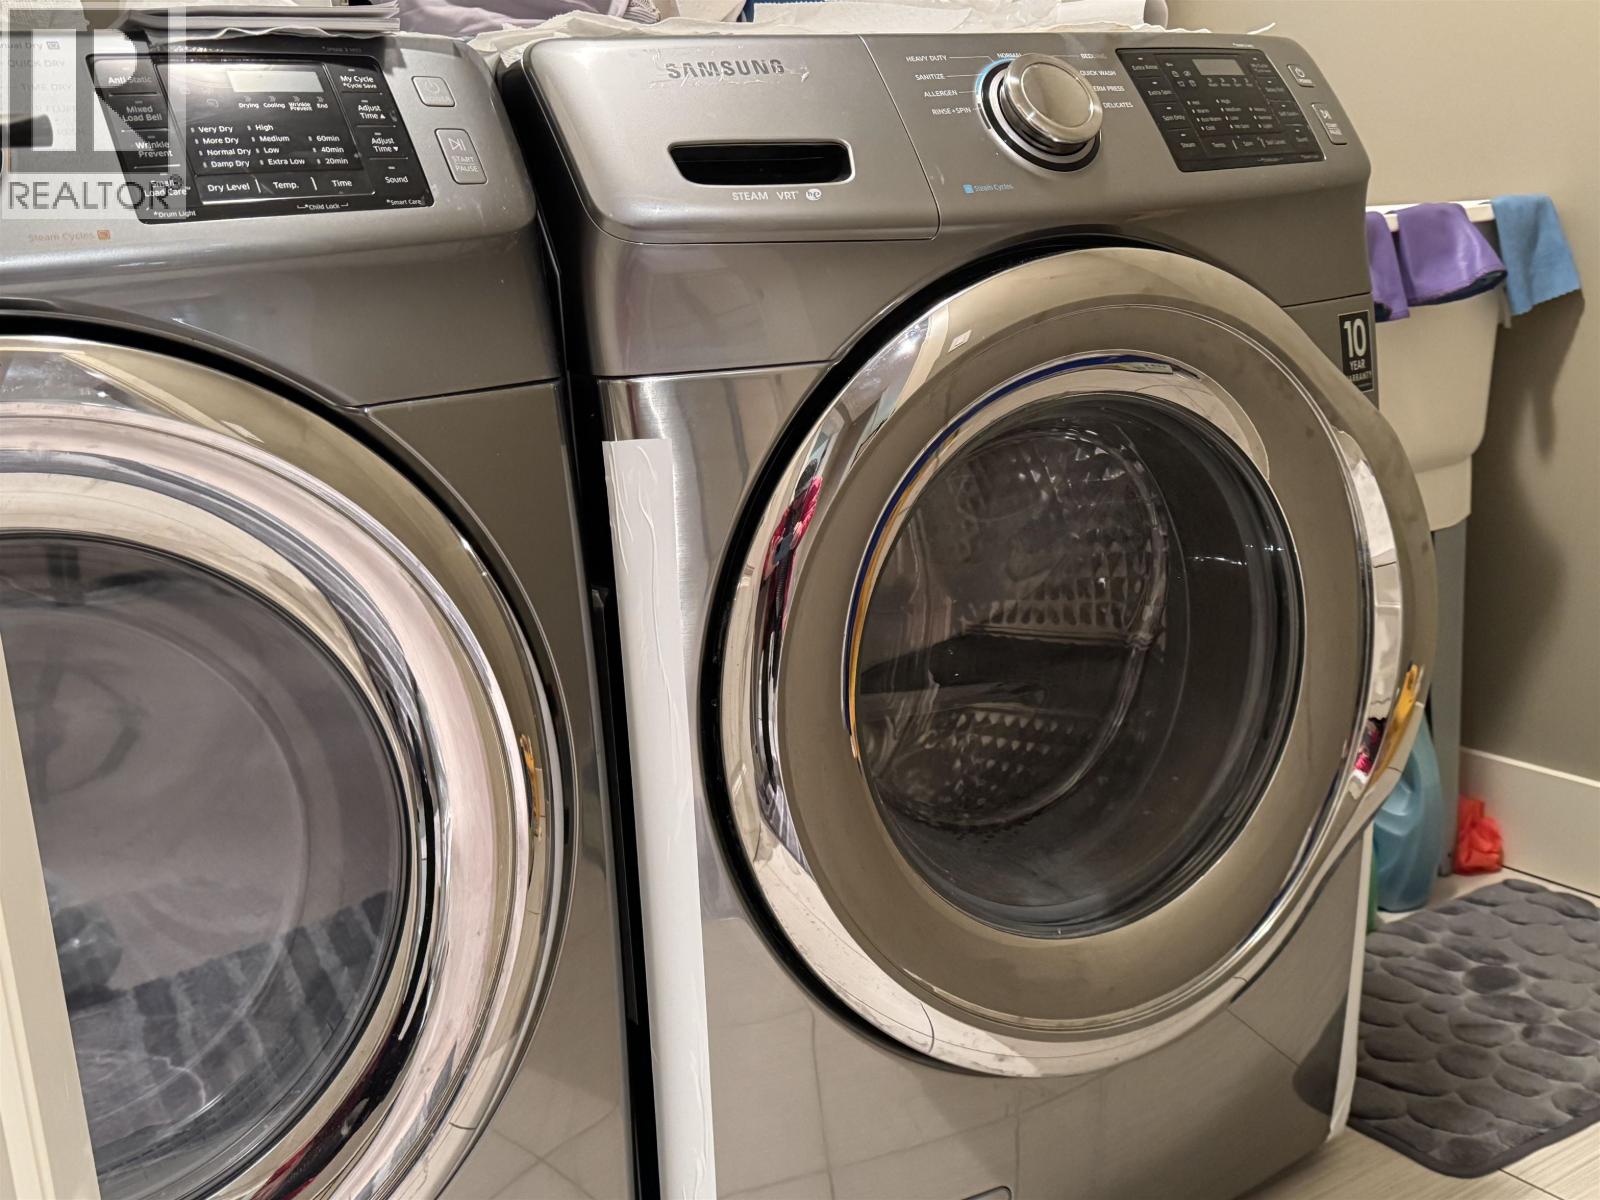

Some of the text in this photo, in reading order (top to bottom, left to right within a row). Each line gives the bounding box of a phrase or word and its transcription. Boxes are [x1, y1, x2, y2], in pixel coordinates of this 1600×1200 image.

[904, 54, 948, 63] HEAVY DUTY
[664, 58, 785, 79] SAMSUNG
[340, 74, 374, 83] My Cycle
[914, 73, 947, 81] SANITIZE
[923, 89, 958, 98] ALLERGEN
[357, 104, 382, 113] Adjust
[1102, 101, 1134, 109] DELICATES
[126, 106, 153, 114] Mixed
[122, 114, 144, 123] Load
[359, 112, 379, 120] Time
[198, 125, 234, 134] Very Dry
[254, 124, 274, 132] High
[202, 136, 240, 145] More Dry
[259, 135, 290, 143] Medium
[316, 135, 341, 143] 60min
[371, 136, 395, 145] Adjust
[135, 141, 170, 149] Wrinkle
[373, 145, 393, 153] Time
[139, 149, 174, 158] Prevent
[206, 148, 252, 157] Normal Dry
[263, 147, 280, 155] Low
[321, 146, 345, 154] 40min
[210, 160, 251, 170] Damp Dry
[267, 157, 306, 166] Extra Low
[325, 158, 349, 166] 20min
[455, 165, 479, 173] PAUSE
[330, 180, 353, 188] Time
[384, 175, 409, 184] Sound
[207, 182, 251, 194] Dry Level
[272, 180, 300, 190] Temp.
[731, 191, 769, 201] STEAM
[28, 230, 95, 242] Steam Cycles
[1343, 318, 1367, 358] 10
[1349, 358, 1367, 371] YEAR
